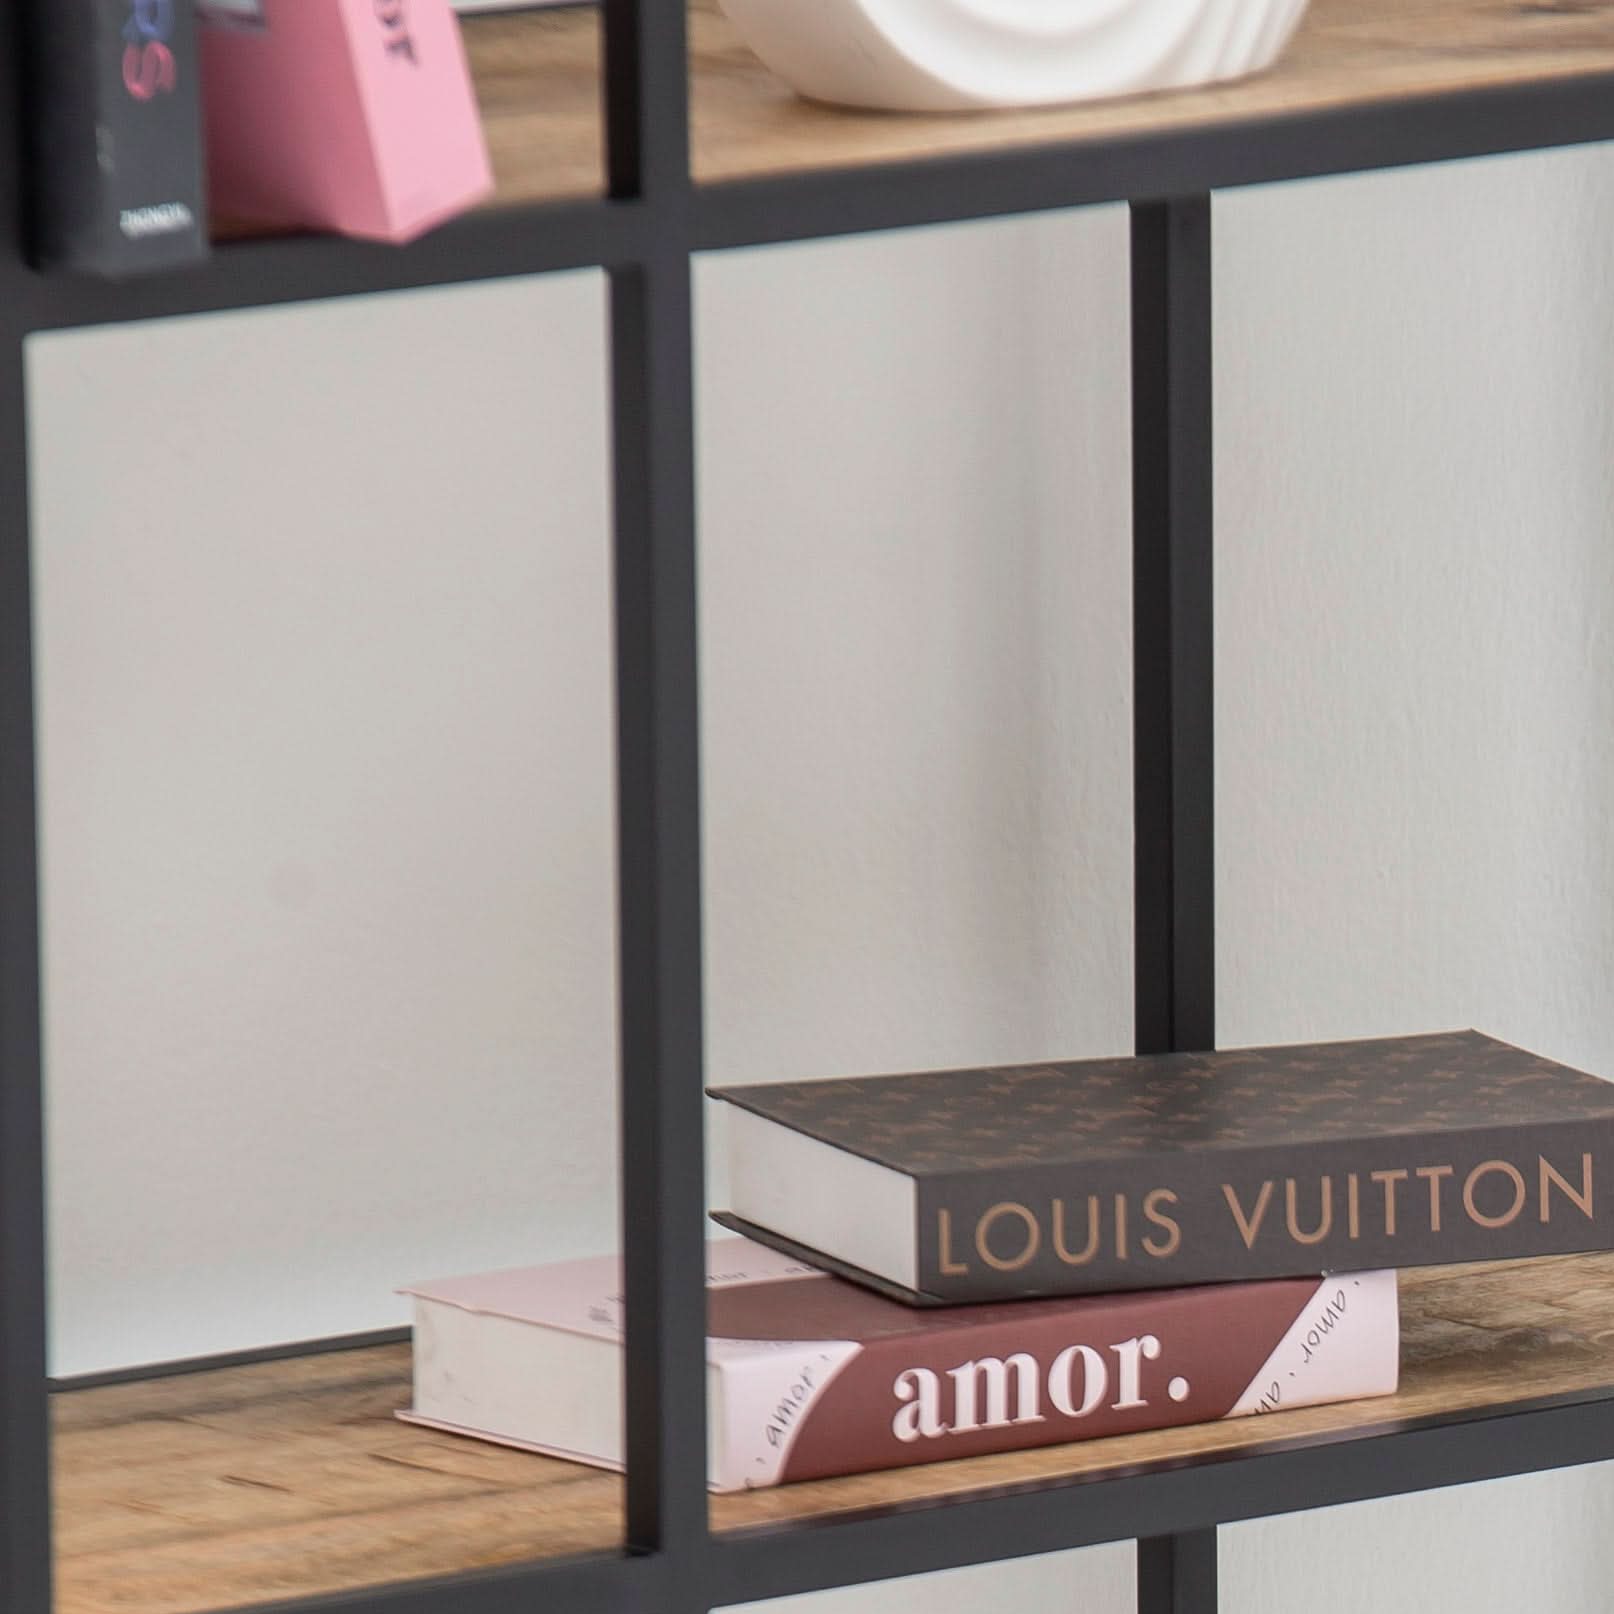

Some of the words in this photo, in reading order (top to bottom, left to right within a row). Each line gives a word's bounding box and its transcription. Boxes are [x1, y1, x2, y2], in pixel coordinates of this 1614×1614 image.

[938, 1188, 1182, 1276] LOUIS
[1222, 1152, 1594, 1250] VUITTON
[1303, 1289, 1346, 1364] amor
[765, 1364, 816, 1448] amor
[891, 1334, 1191, 1442] amor.
